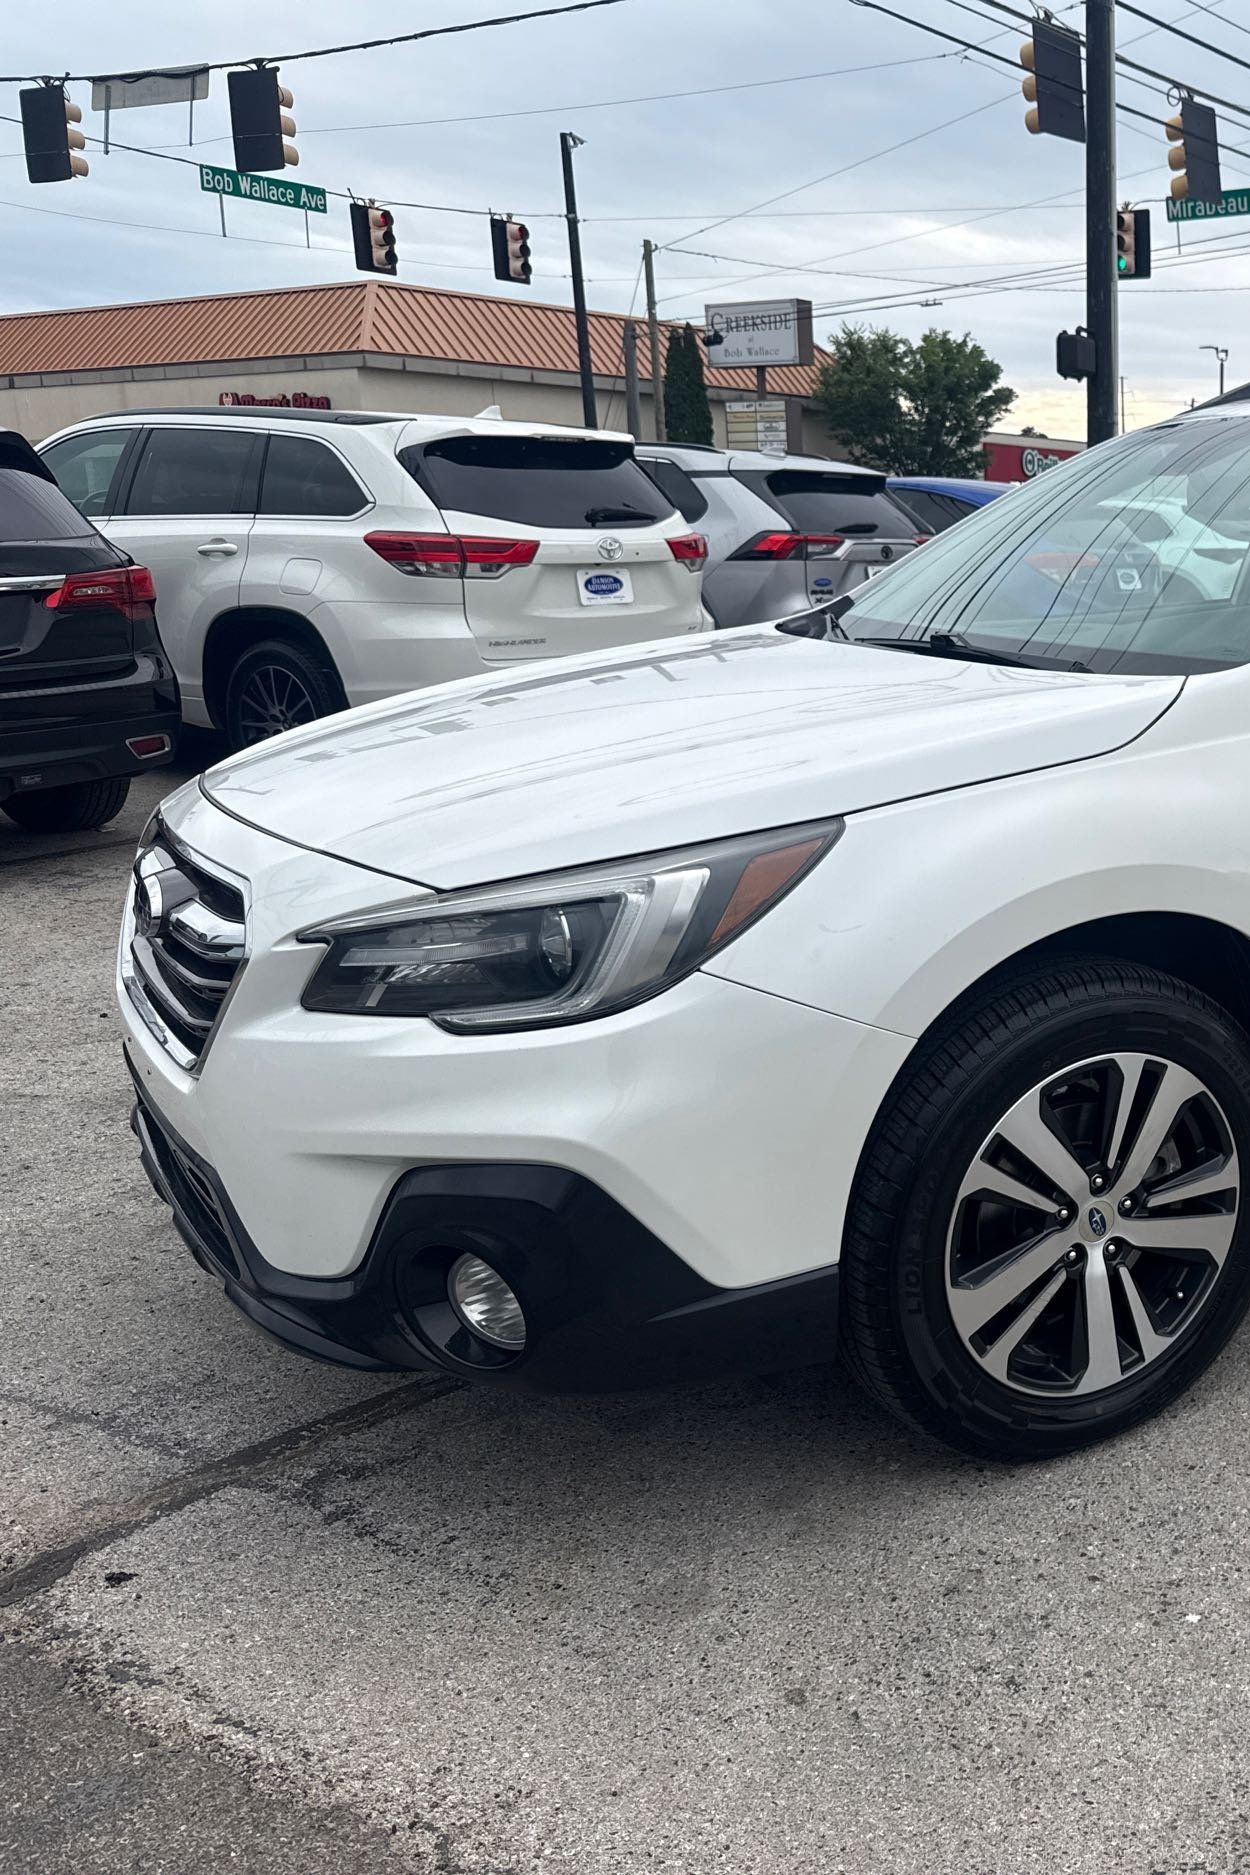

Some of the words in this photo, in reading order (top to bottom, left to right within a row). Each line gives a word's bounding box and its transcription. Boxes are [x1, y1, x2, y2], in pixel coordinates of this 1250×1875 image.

[202, 168, 233, 192] Bob
[238, 175, 294, 203] Wallace
[300, 188, 325, 209] Ave
[1168, 196, 1248, 219] Mirabeau
[746, 346, 779, 357] Wallace
